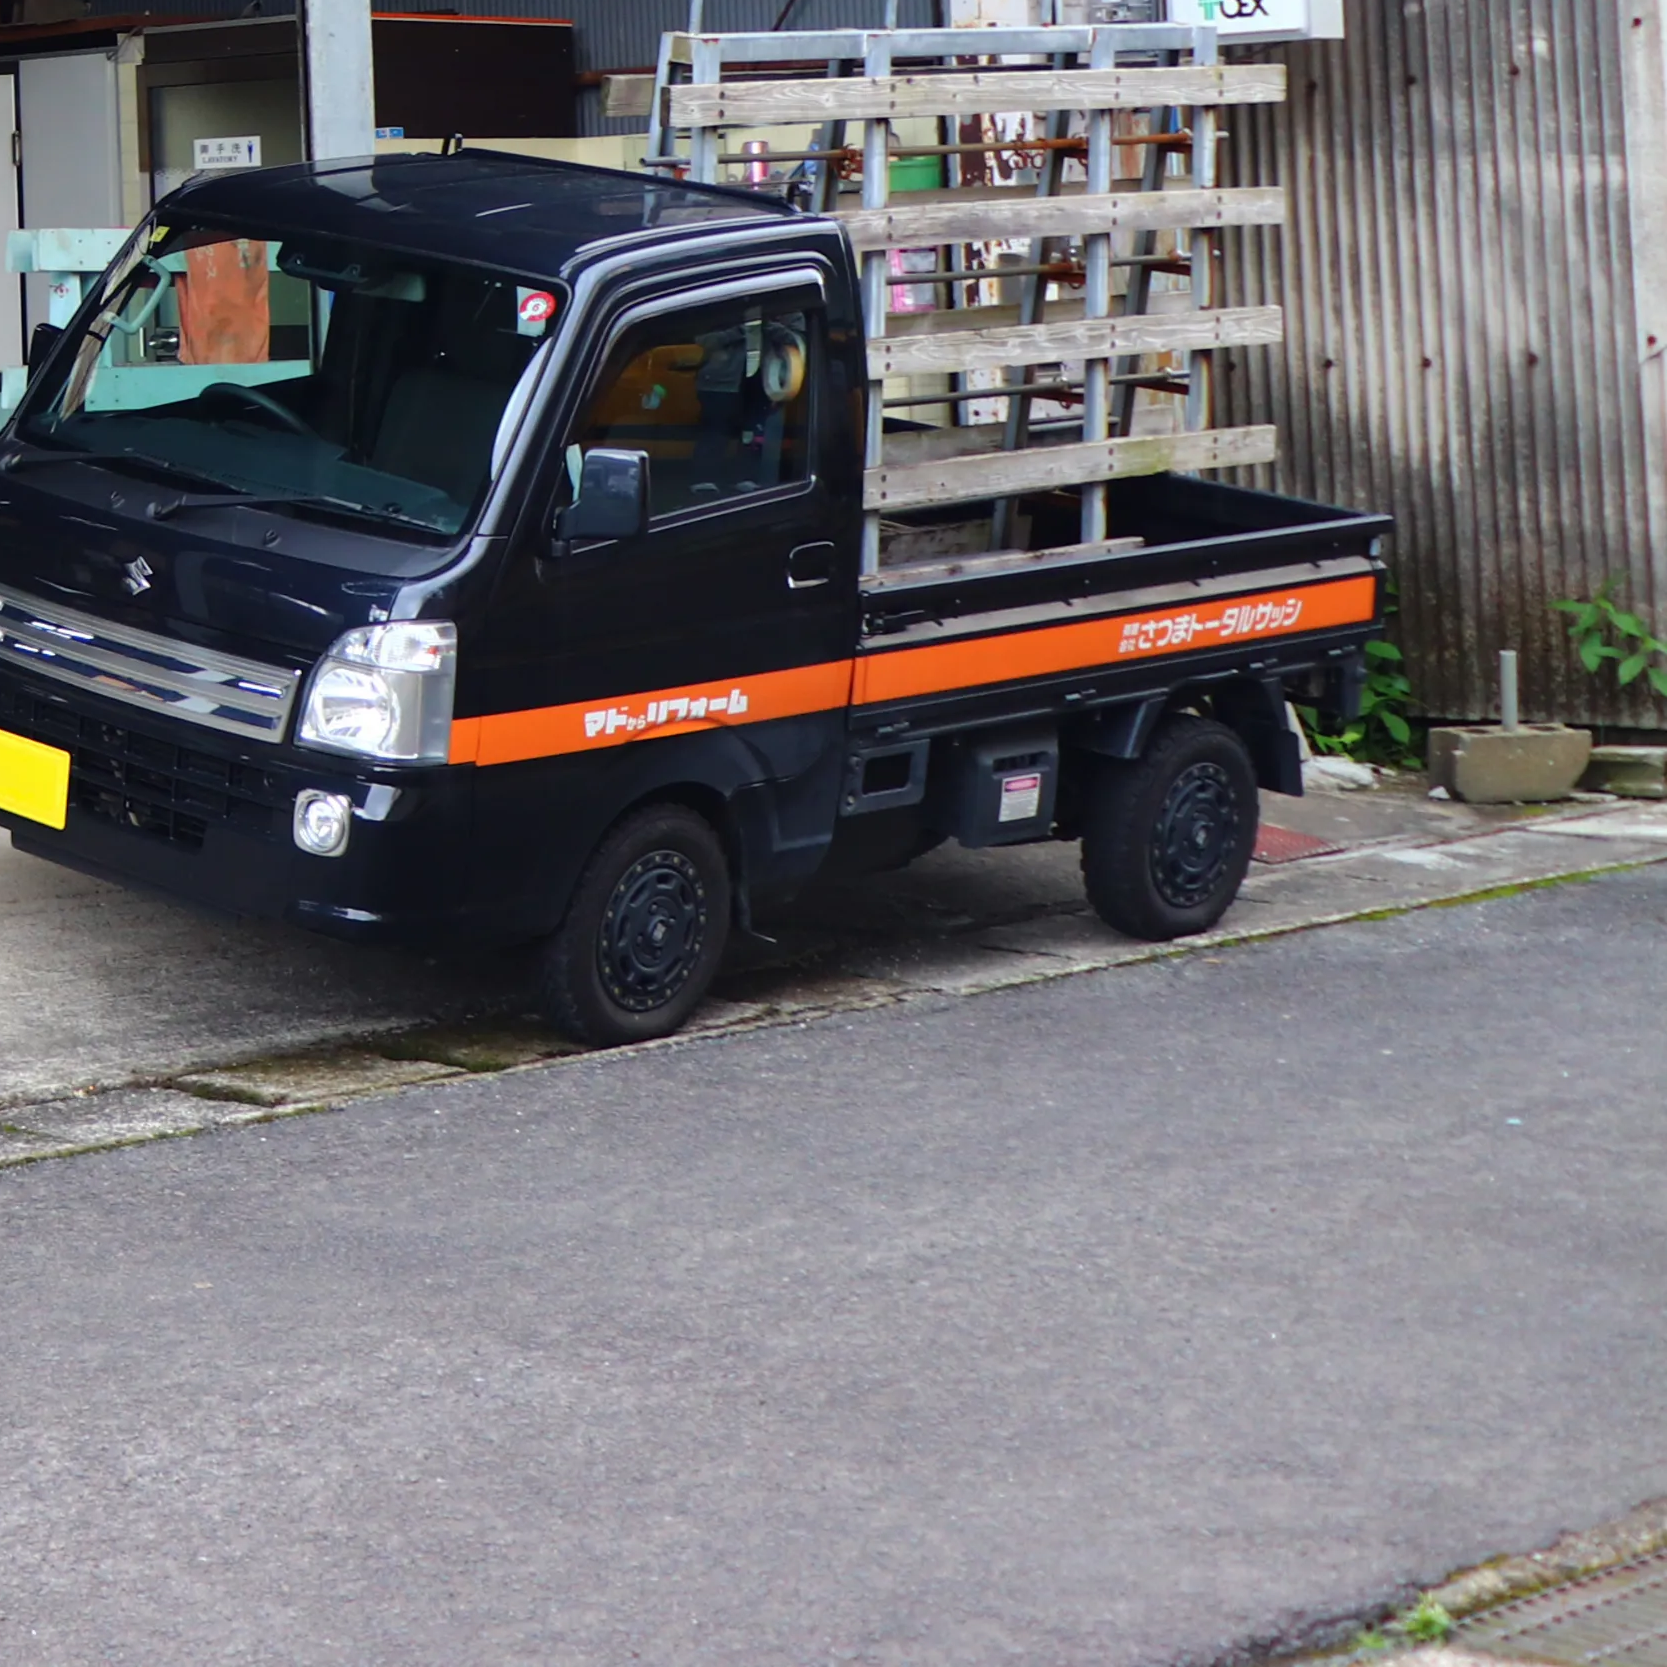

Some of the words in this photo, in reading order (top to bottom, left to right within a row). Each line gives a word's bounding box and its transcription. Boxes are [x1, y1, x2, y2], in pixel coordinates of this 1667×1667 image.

[202, 155, 239, 164] LAVATORY
[584, 688, 749, 739] マドからリフォーム
